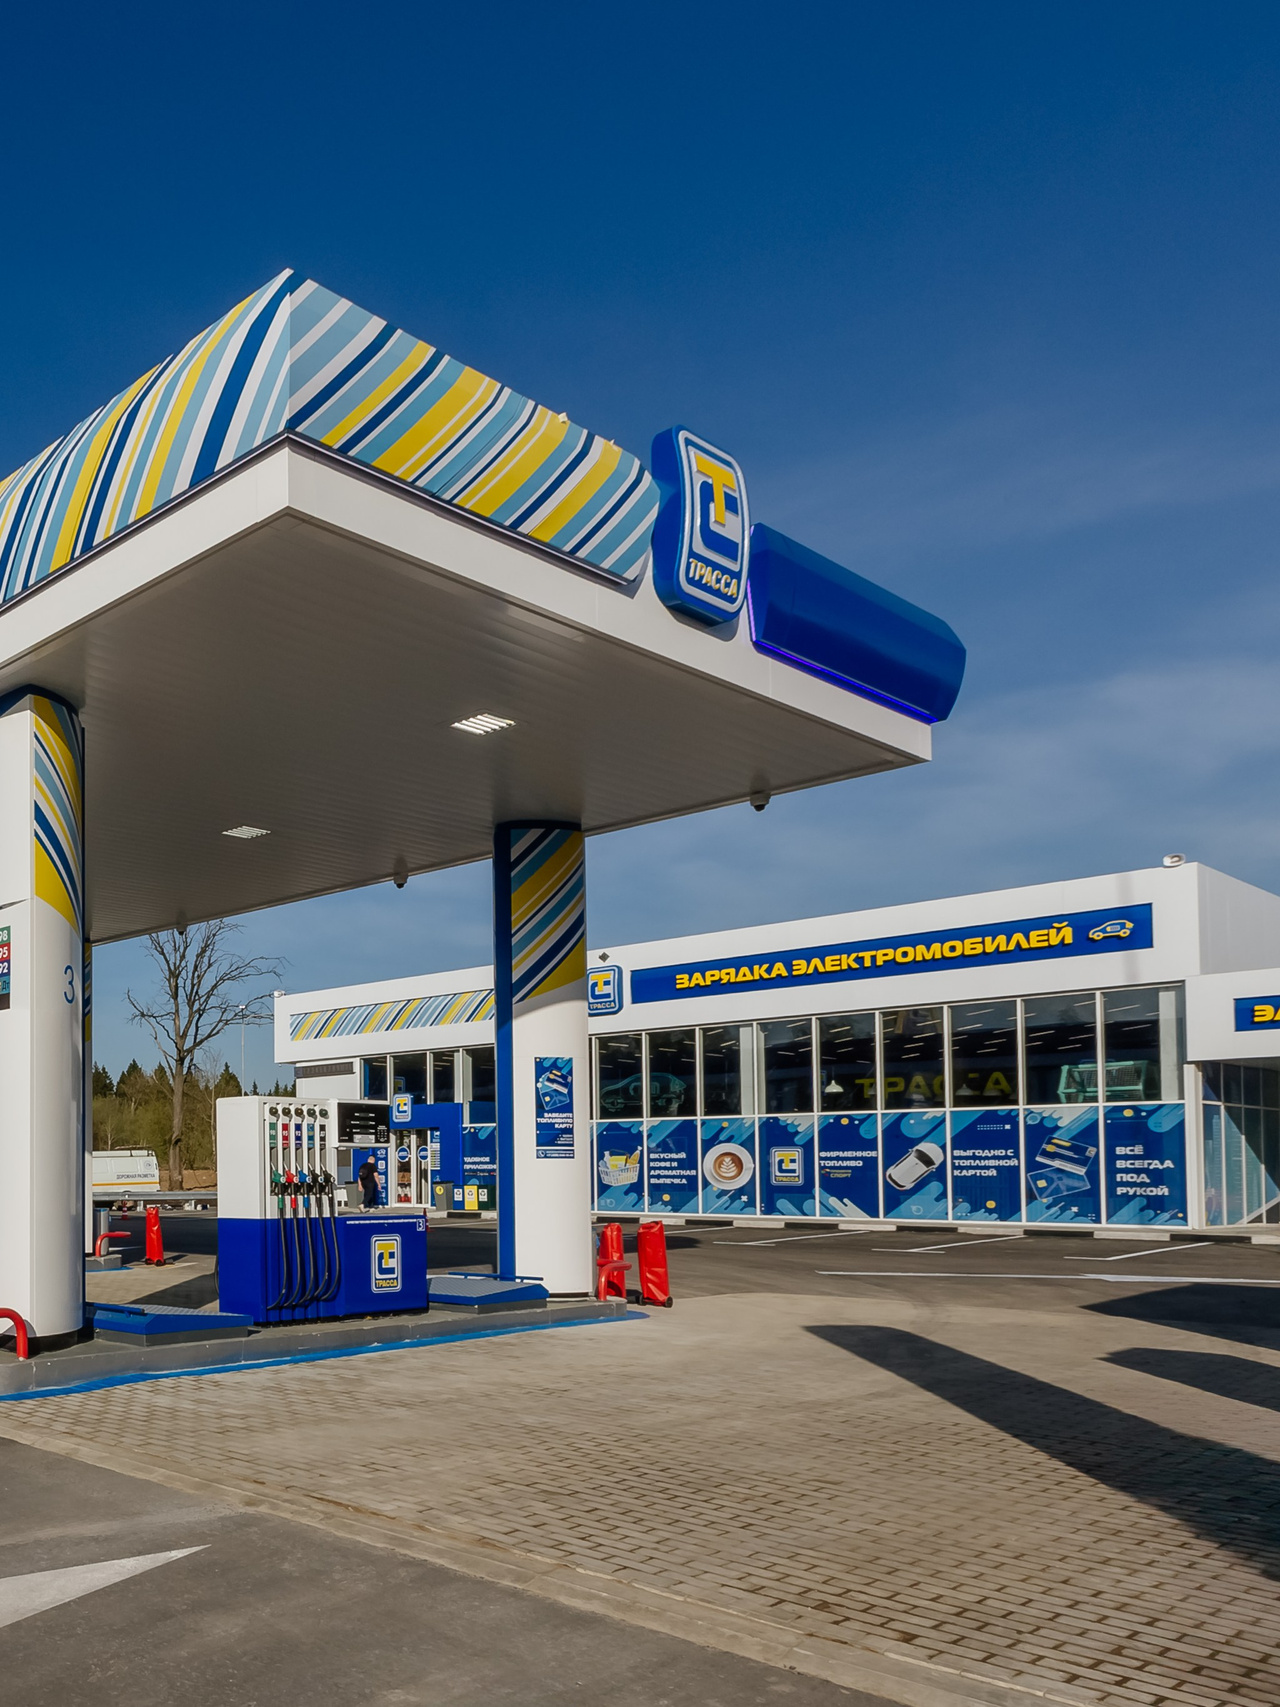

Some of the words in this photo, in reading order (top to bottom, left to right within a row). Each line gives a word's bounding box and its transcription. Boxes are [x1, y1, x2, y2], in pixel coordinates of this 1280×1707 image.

[689, 558, 738, 598] ТРАССА
[675, 962, 789, 989] ЗАРЯДКА
[792, 922, 1073, 976] ЭЛЕКТРОМОБИЛЕЙ
[64, 965, 75, 1004] 3
[1115, 1145, 1144, 1155] ВСЁ
[953, 1158, 1018, 1166] ТОПЛИВНОЙ
[1116, 1160, 1175, 1169] ВСЕГДА
[954, 1168, 997, 1176] КАРТОЙ
[1116, 1173, 1150, 1183] ПОД
[1116, 1185, 1169, 1195] РУКОЙ
[375, 1279, 398, 1287] ТРАССА
